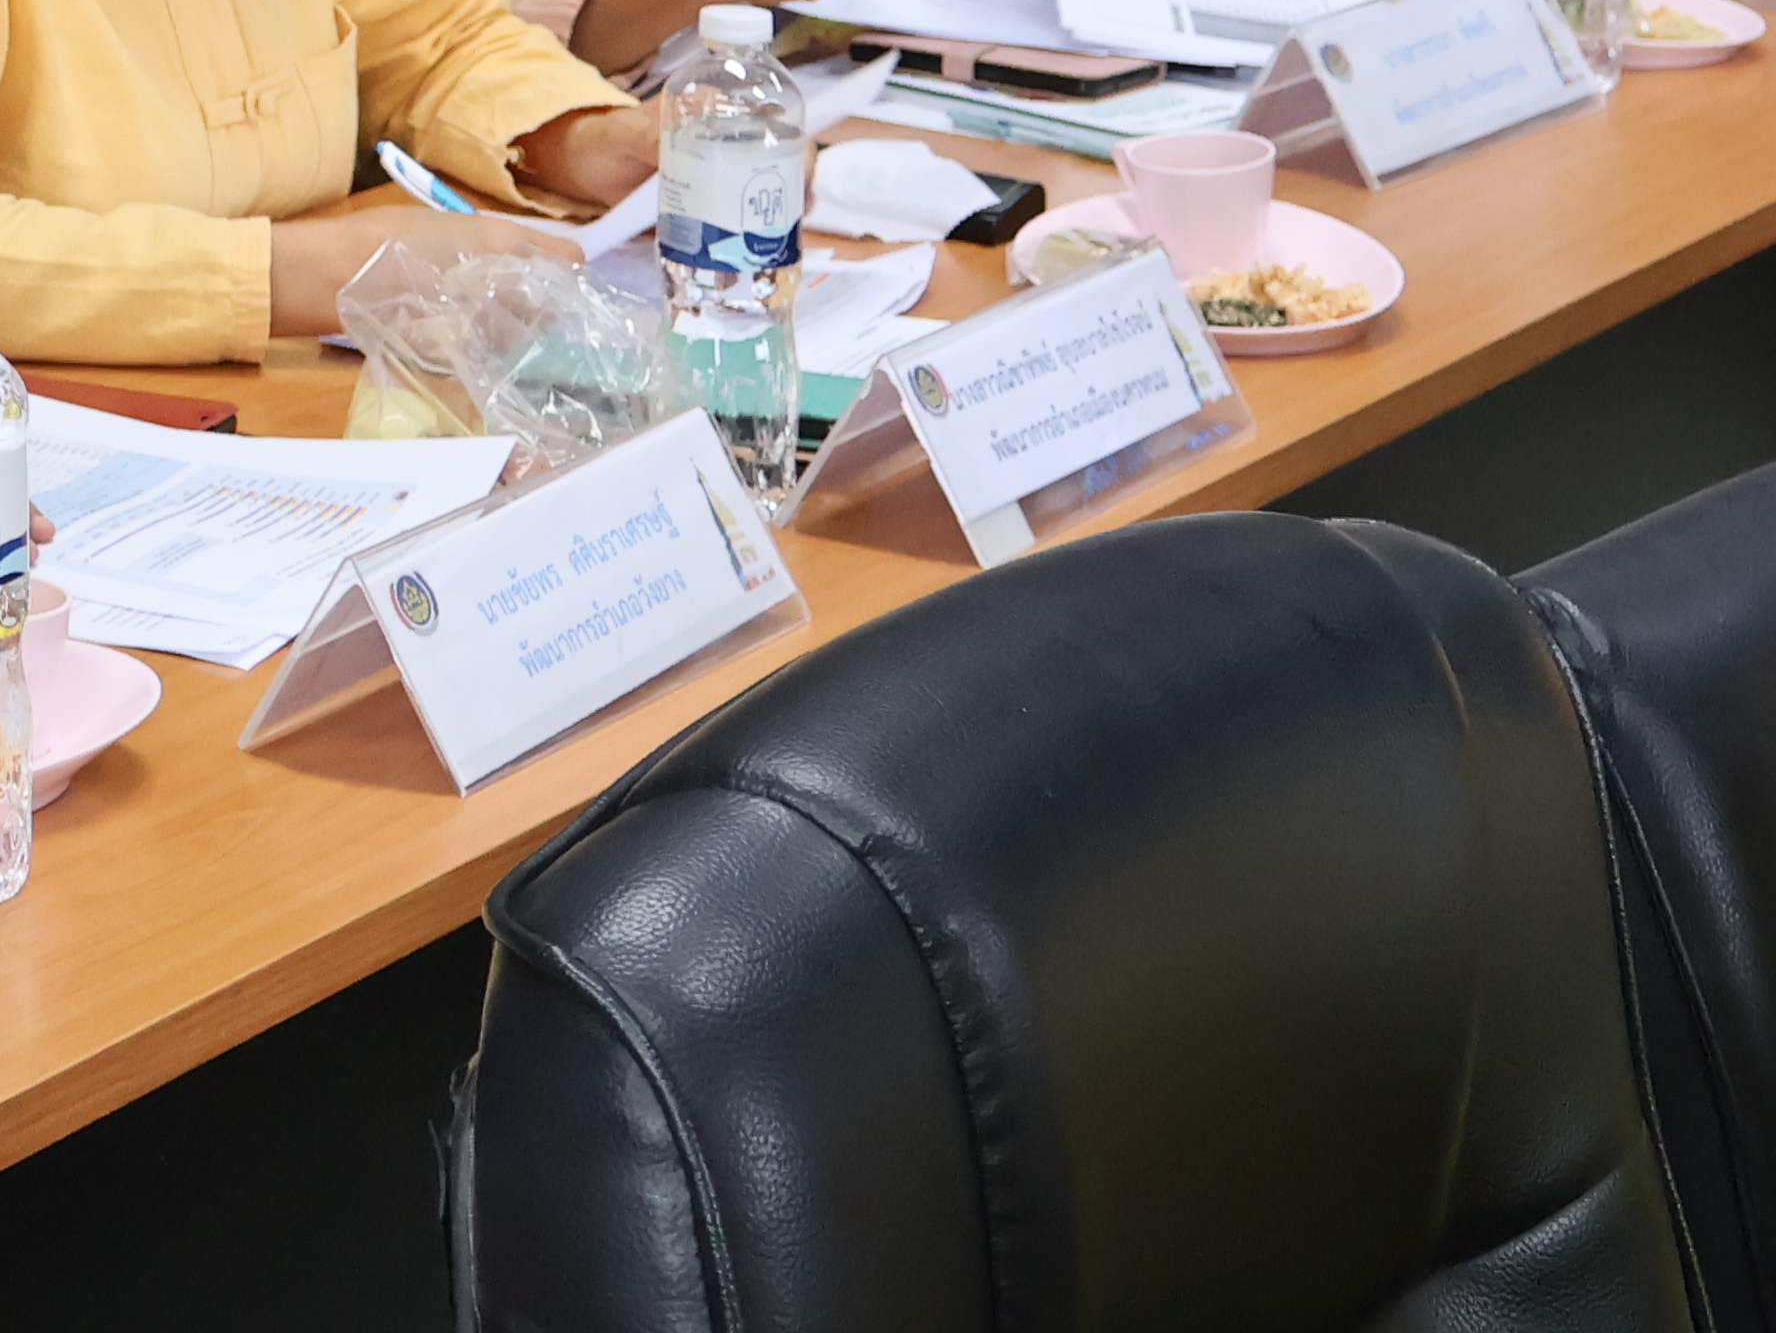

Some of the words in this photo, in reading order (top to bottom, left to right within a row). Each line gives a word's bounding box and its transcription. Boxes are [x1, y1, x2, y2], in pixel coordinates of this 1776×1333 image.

[477, 564, 564, 625] นายชัยพร
[518, 569, 687, 678] พัฒนาการอำเภอวังยาง
